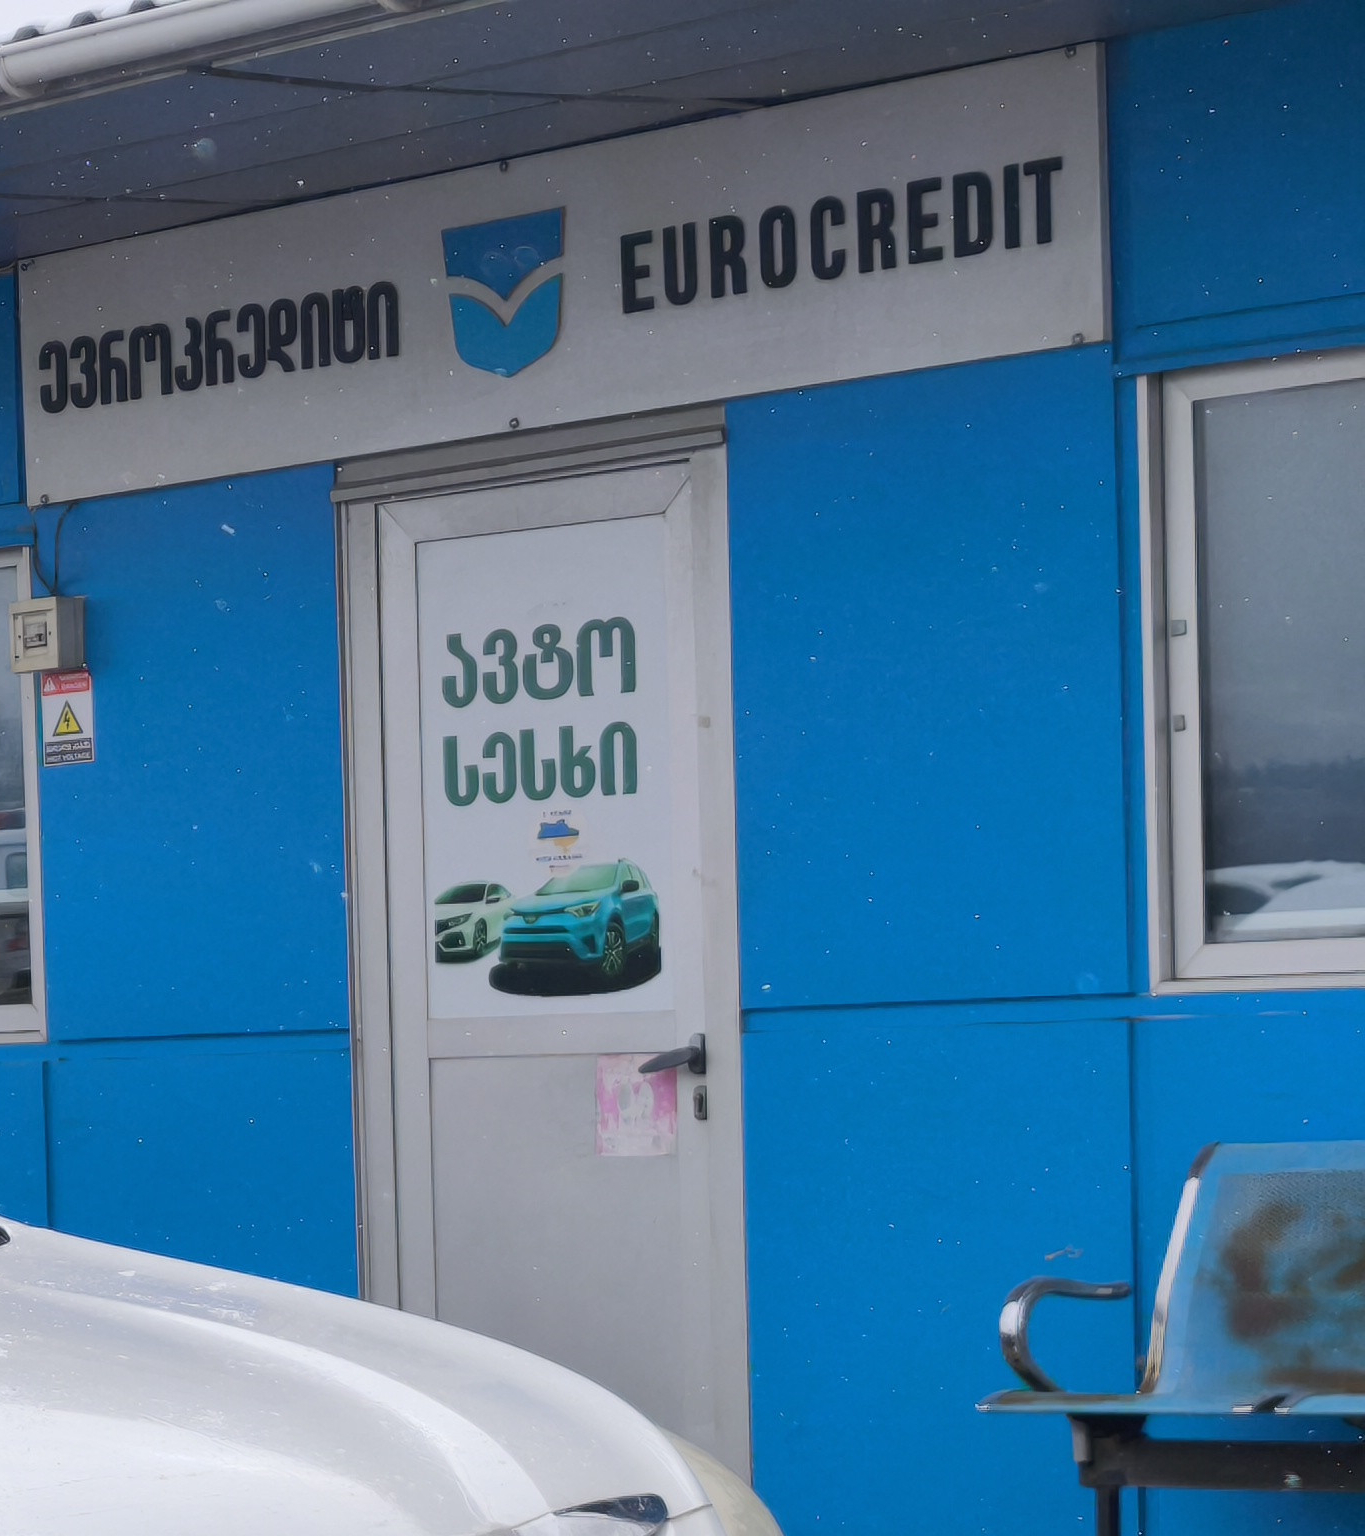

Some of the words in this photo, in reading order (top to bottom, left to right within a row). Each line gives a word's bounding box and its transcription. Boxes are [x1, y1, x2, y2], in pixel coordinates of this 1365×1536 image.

[620, 156, 1064, 314] EUROCREDIT
[38, 281, 400, 414] ევროკრედიტი
[441, 616, 637, 709] ავტო
[62, 751, 91, 761] VOLTAGE
[442, 721, 638, 806] სესხი
